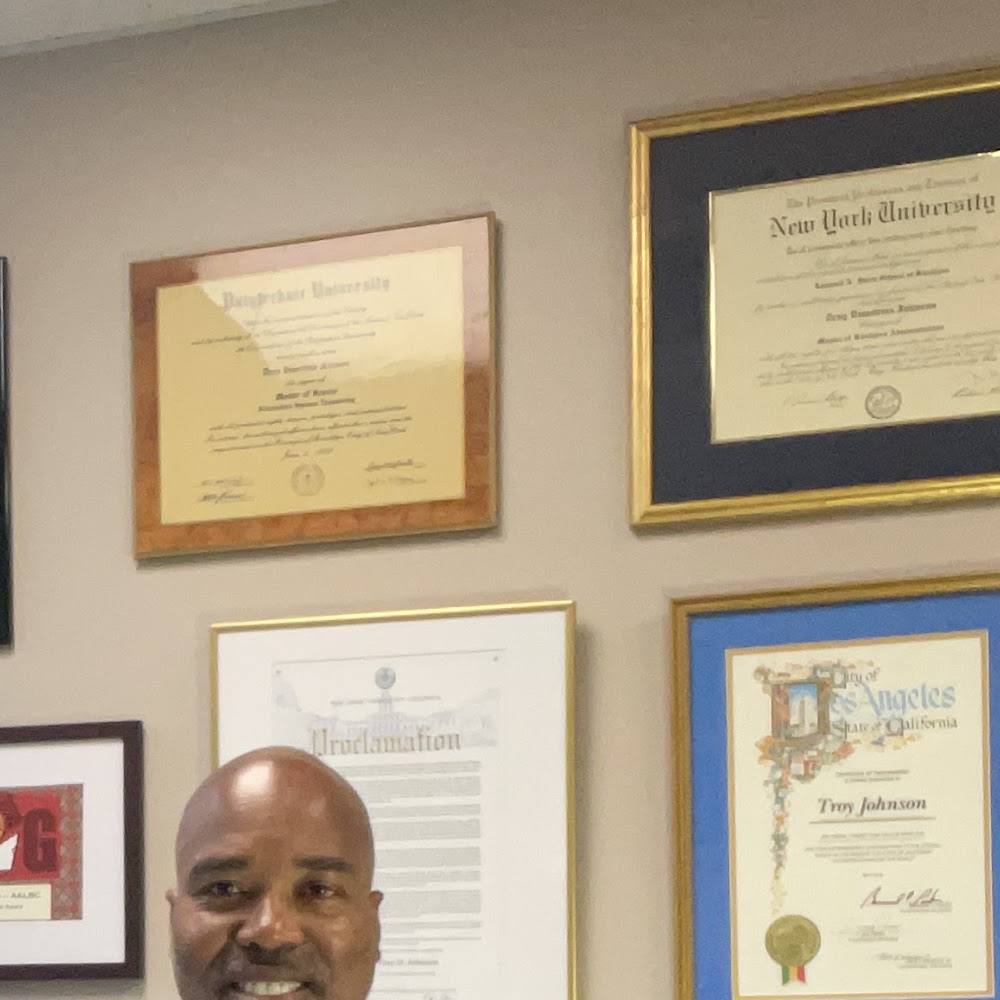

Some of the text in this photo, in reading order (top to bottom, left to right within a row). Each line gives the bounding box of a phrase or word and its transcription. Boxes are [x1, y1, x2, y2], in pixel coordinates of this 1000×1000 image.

[769, 193, 996, 238] New York University
[818, 796, 927, 817] Troy Johnson
